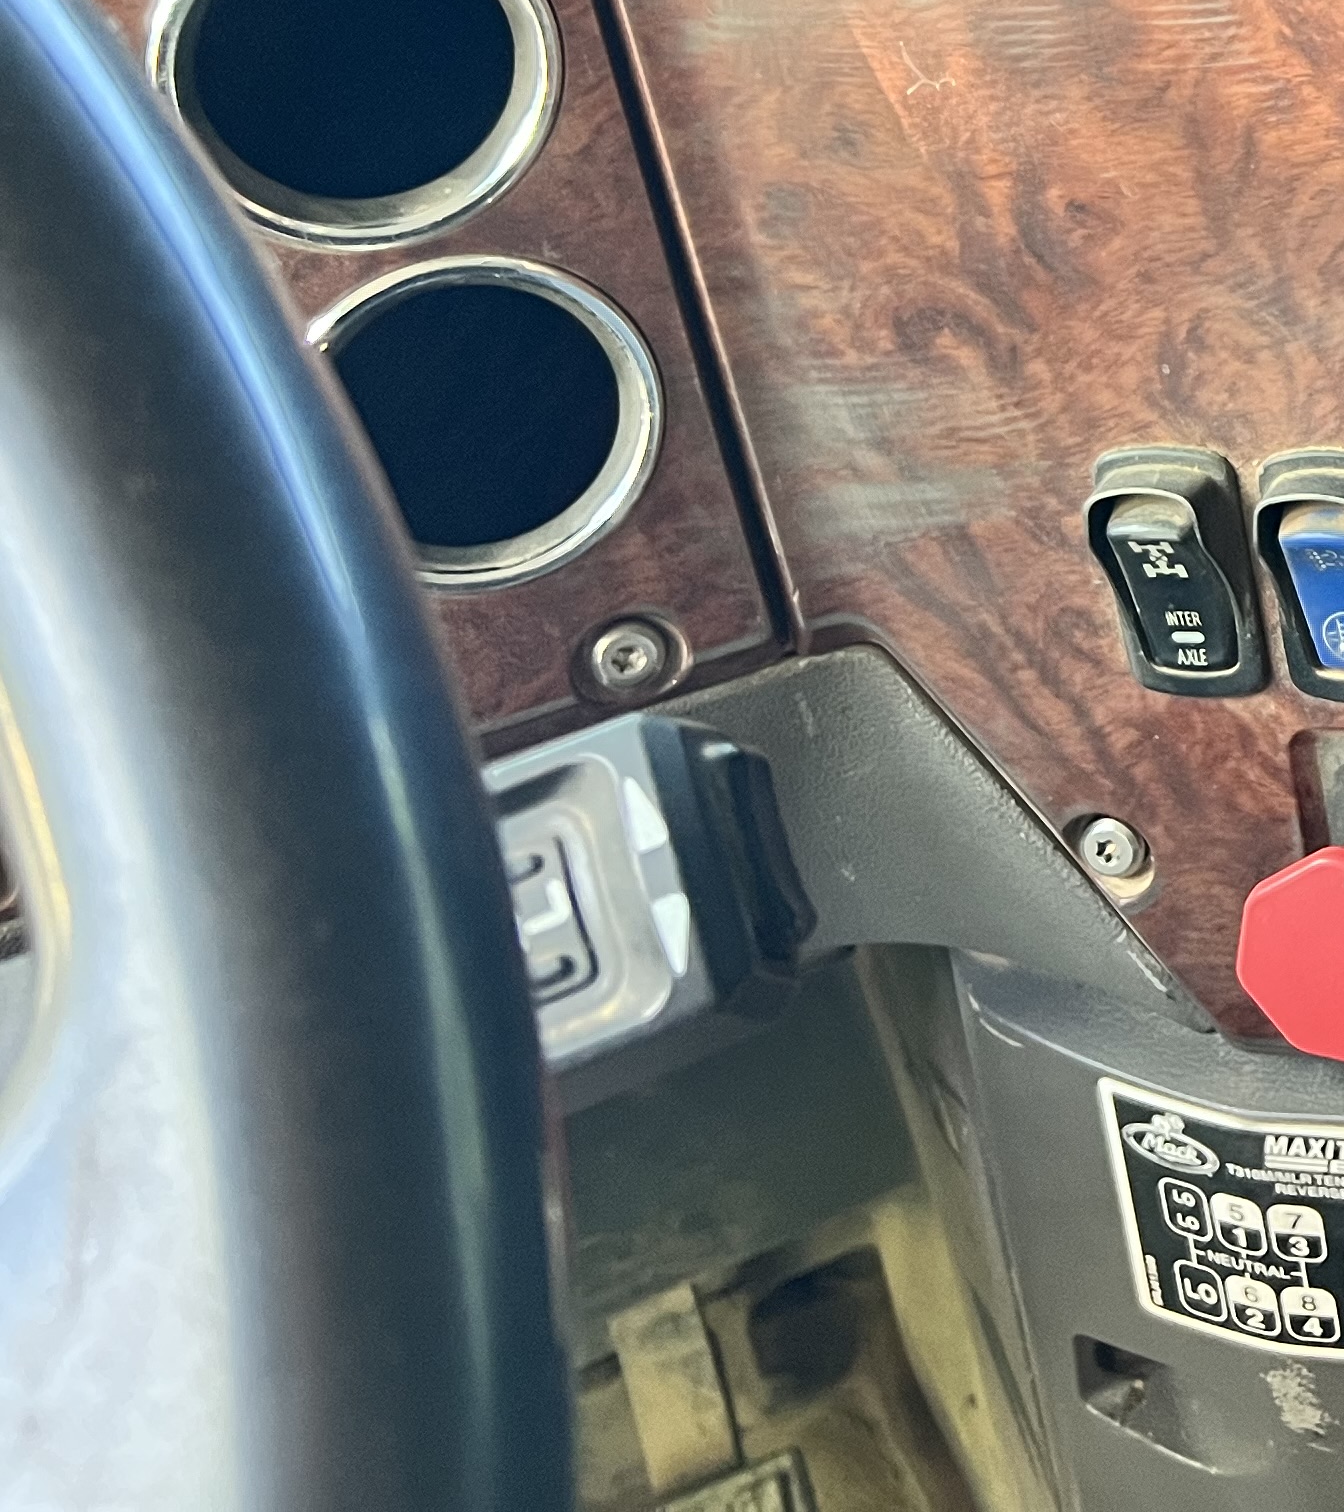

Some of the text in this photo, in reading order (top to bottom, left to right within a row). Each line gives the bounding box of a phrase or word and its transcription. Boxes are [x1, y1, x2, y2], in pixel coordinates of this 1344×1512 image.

[1164, 609, 1203, 628] INTER
[1177, 647, 1209, 667] AXLE
[1140, 1130, 1204, 1167] Mack
[1172, 1188, 1197, 1208] LO
[1176, 1212, 1201, 1232] LO
[1228, 1202, 1245, 1223] 5
[1284, 1212, 1303, 1229] 7
[1231, 1227, 1248, 1248] 1
[1288, 1235, 1311, 1257] 3
[1207, 1249, 1292, 1280] NEUTRAL
[1183, 1277, 1219, 1305] LO
[1244, 1286, 1259, 1303] 6
[1301, 1295, 1317, 1312] 8
[1245, 1307, 1266, 1330] 2
[1302, 1316, 1324, 1337] 4
